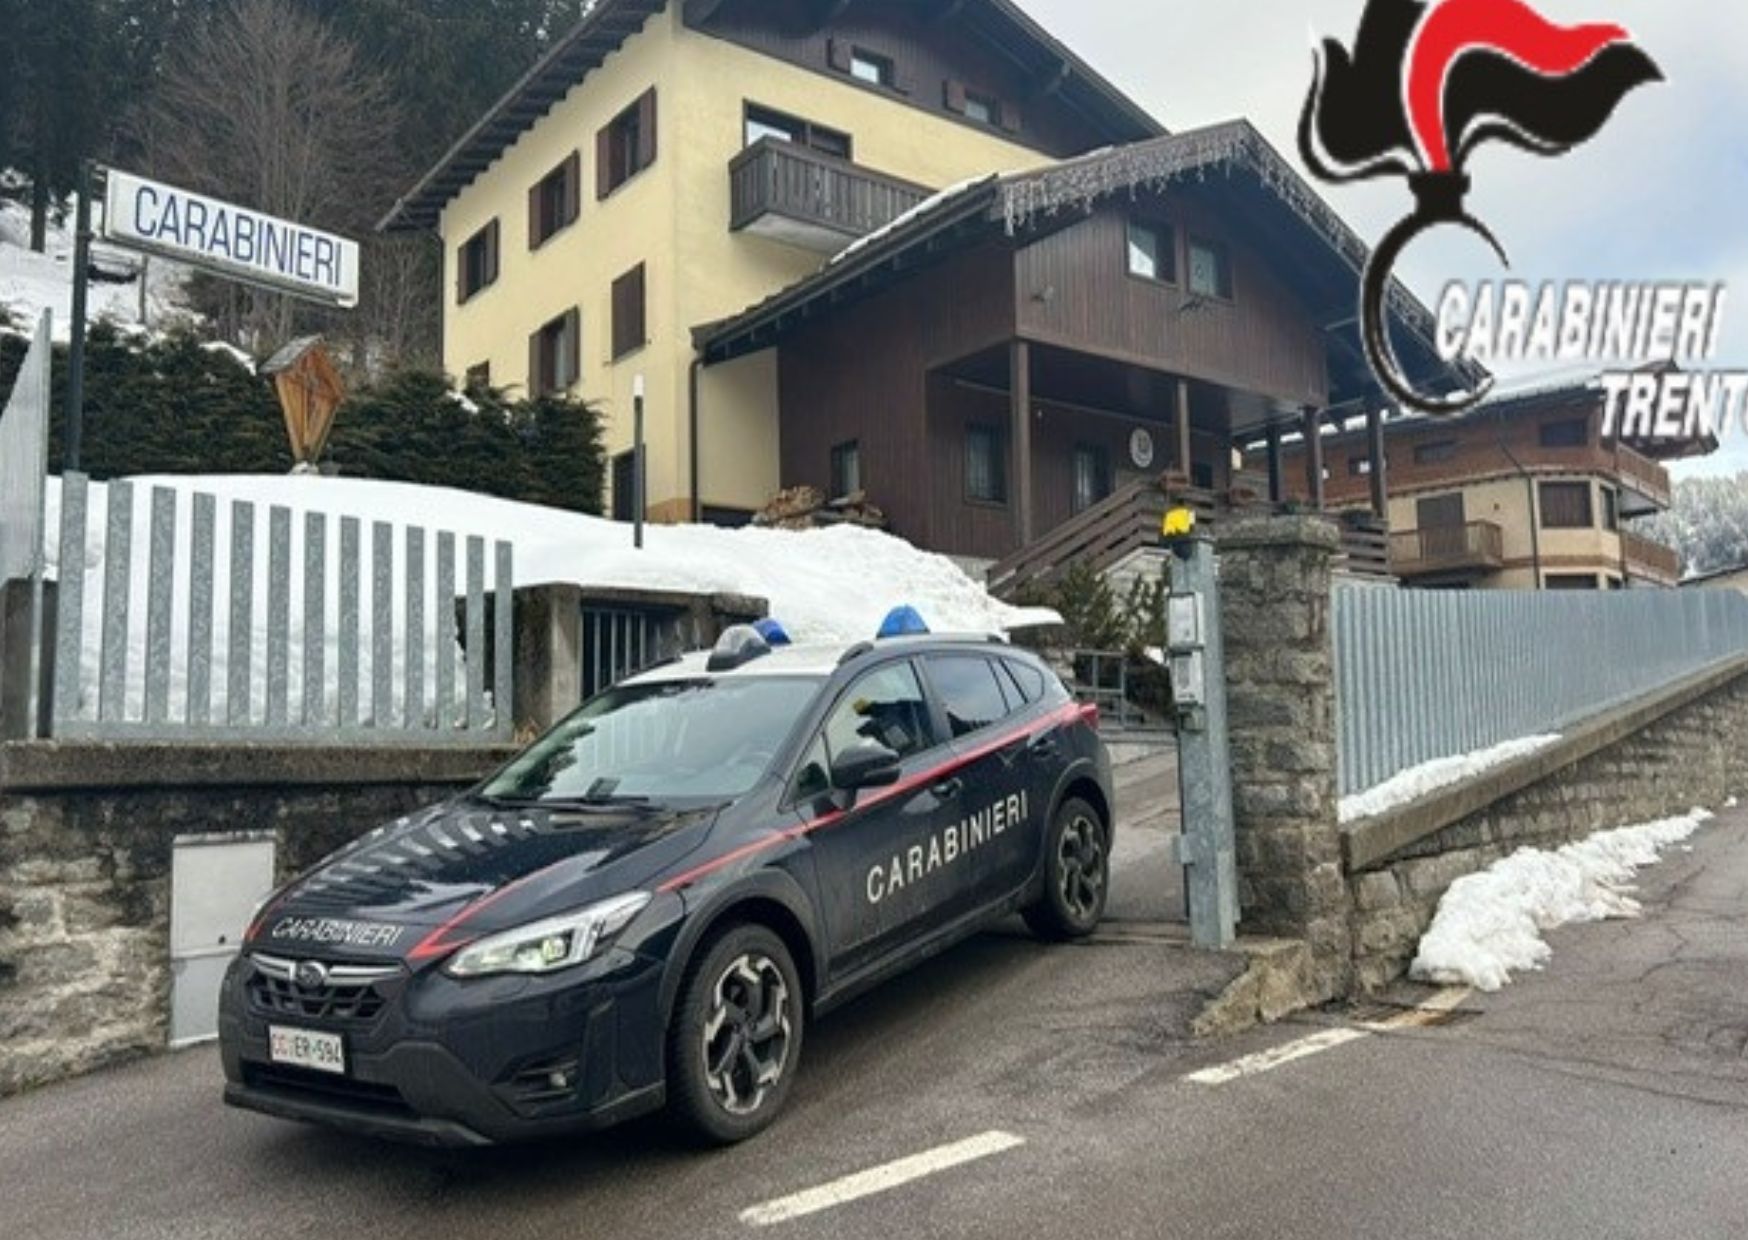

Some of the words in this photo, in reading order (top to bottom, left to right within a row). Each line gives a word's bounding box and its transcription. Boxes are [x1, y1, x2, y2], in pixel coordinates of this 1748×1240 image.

[135, 186, 342, 287] CARABINIERI
[866, 789, 1028, 904] CARABINIERI
[272, 917, 404, 946] CARABINIERI
